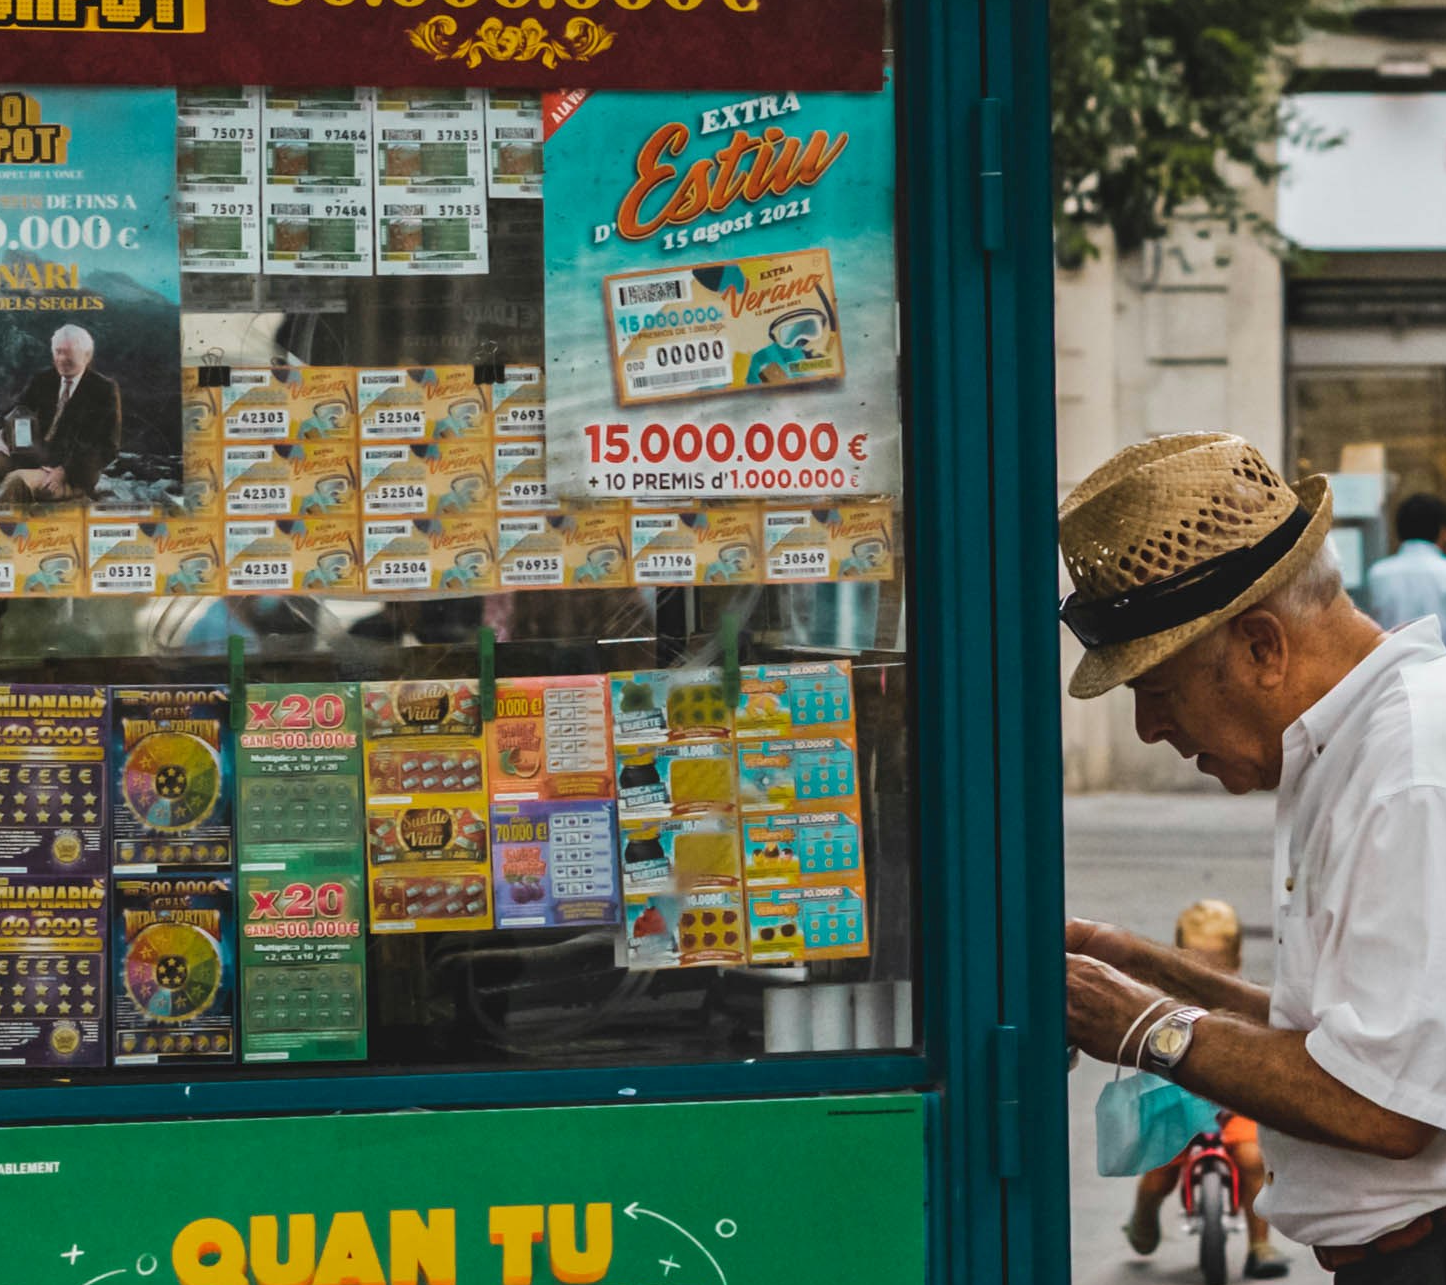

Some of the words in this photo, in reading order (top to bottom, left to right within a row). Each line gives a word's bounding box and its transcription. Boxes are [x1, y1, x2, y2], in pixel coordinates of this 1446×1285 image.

[700, 91, 802, 136] EXTRA
[211, 127, 255, 139] 75073
[47, 194, 73, 210] DE
[76, 194, 119, 210] FINS
[122, 195, 137, 210] A
[211, 203, 254, 215] 75073
[662, 231, 687, 251] 15
[692, 213, 754, 245] agost
[759, 196, 812, 224] 2021
[721, 273, 825, 320] Verano
[39, 296, 105, 311] SEGLES
[656, 340, 724, 368] 00000
[240, 411, 285, 424] 42303
[378, 411, 421, 424] 52504
[510, 409, 546, 421] 9693
[584, 421, 839, 464] 15.000.000
[605, 473, 626, 491] 10
[632, 472, 705, 491] PREMIS
[242, 487, 286, 500] 42303
[381, 485, 424, 498] 52504
[513, 484, 547, 496] 9693
[652, 555, 692, 568] 17196
[783, 552, 825, 565] 30569
[108, 565, 152, 578] 05312
[244, 563, 288, 575] 42303
[384, 561, 427, 574] 52504
[245, 693, 345, 730] x20
[404, 705, 441, 721] Vida
[407, 831, 444, 848] Vida
[248, 882, 346, 920] x20
